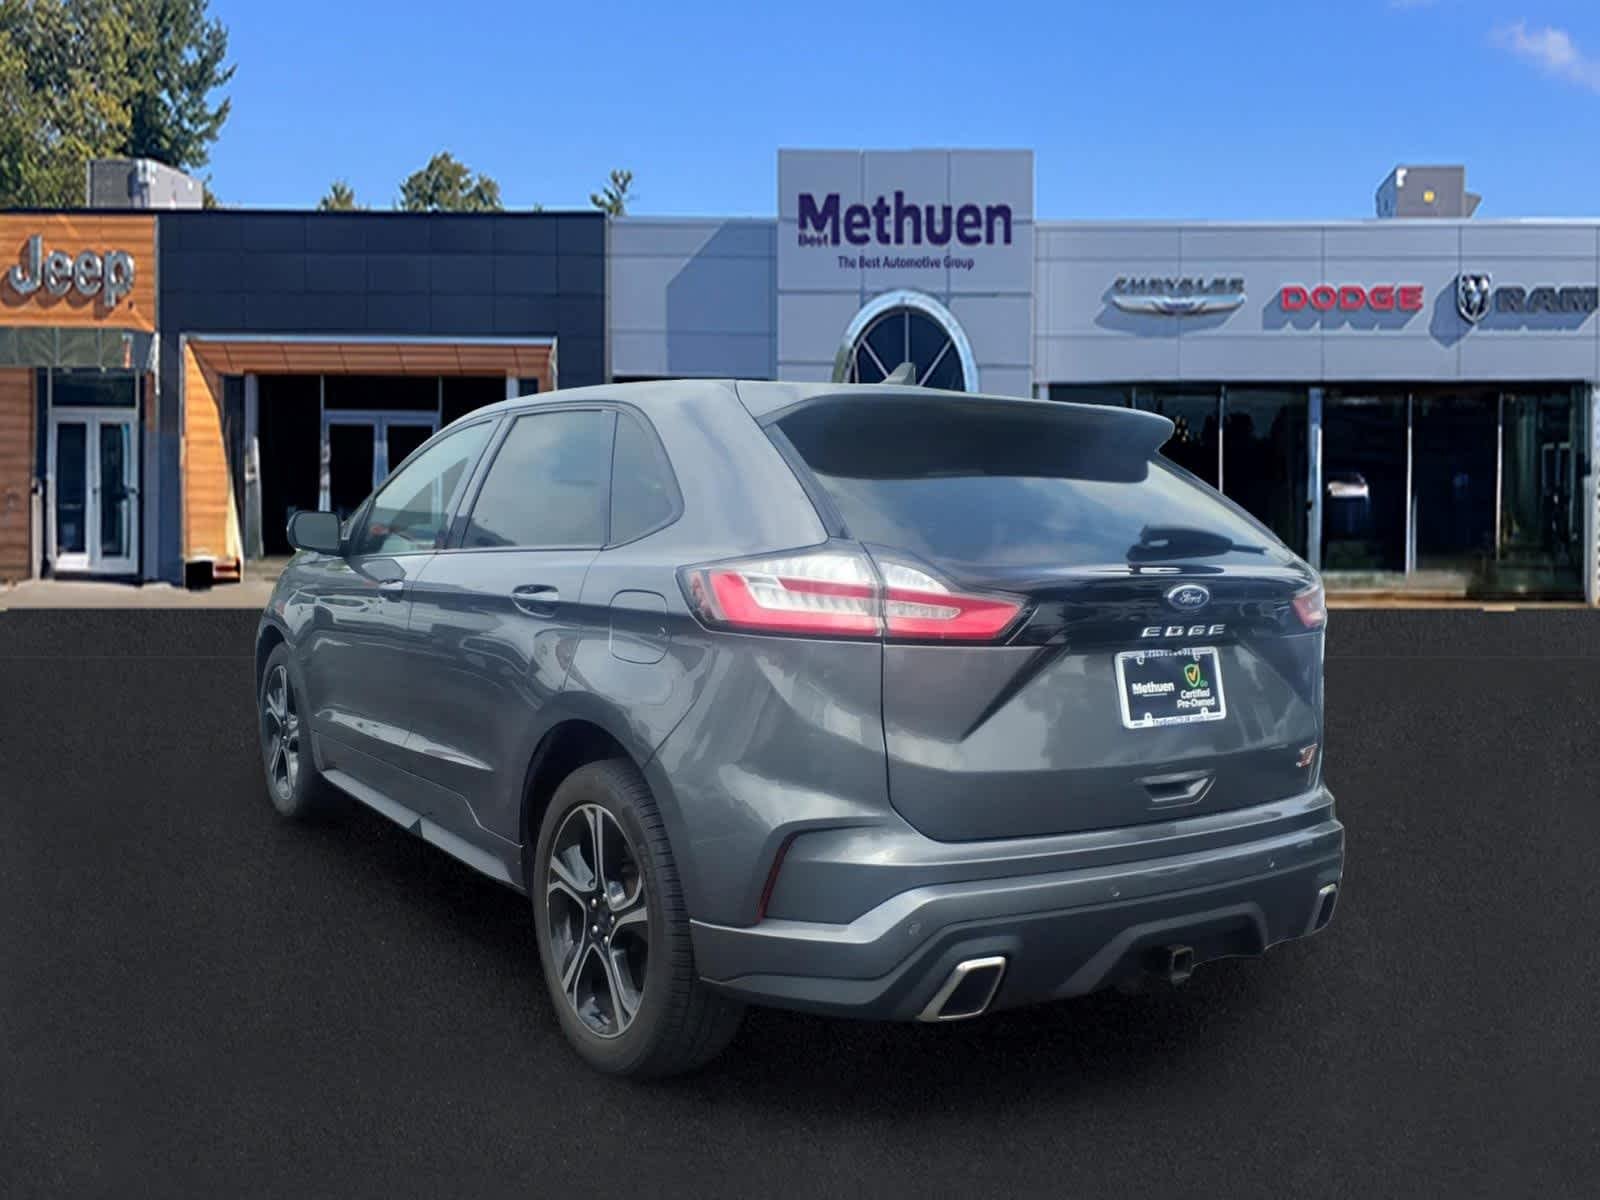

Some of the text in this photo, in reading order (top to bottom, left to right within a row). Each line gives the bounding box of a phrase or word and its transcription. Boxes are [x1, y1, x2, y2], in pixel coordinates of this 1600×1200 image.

[797, 190, 1013, 246] Methuen
[9, 234, 135, 307] Jeep
[838, 255, 976, 271] The Best Automotive Group
[1113, 277, 1245, 294] CHRYSLER
[1281, 285, 1424, 312] DODGE
[1495, 286, 1599, 313] RAM
[1141, 624, 1226, 638] EDGE
[1132, 681, 1175, 695] Methuen
